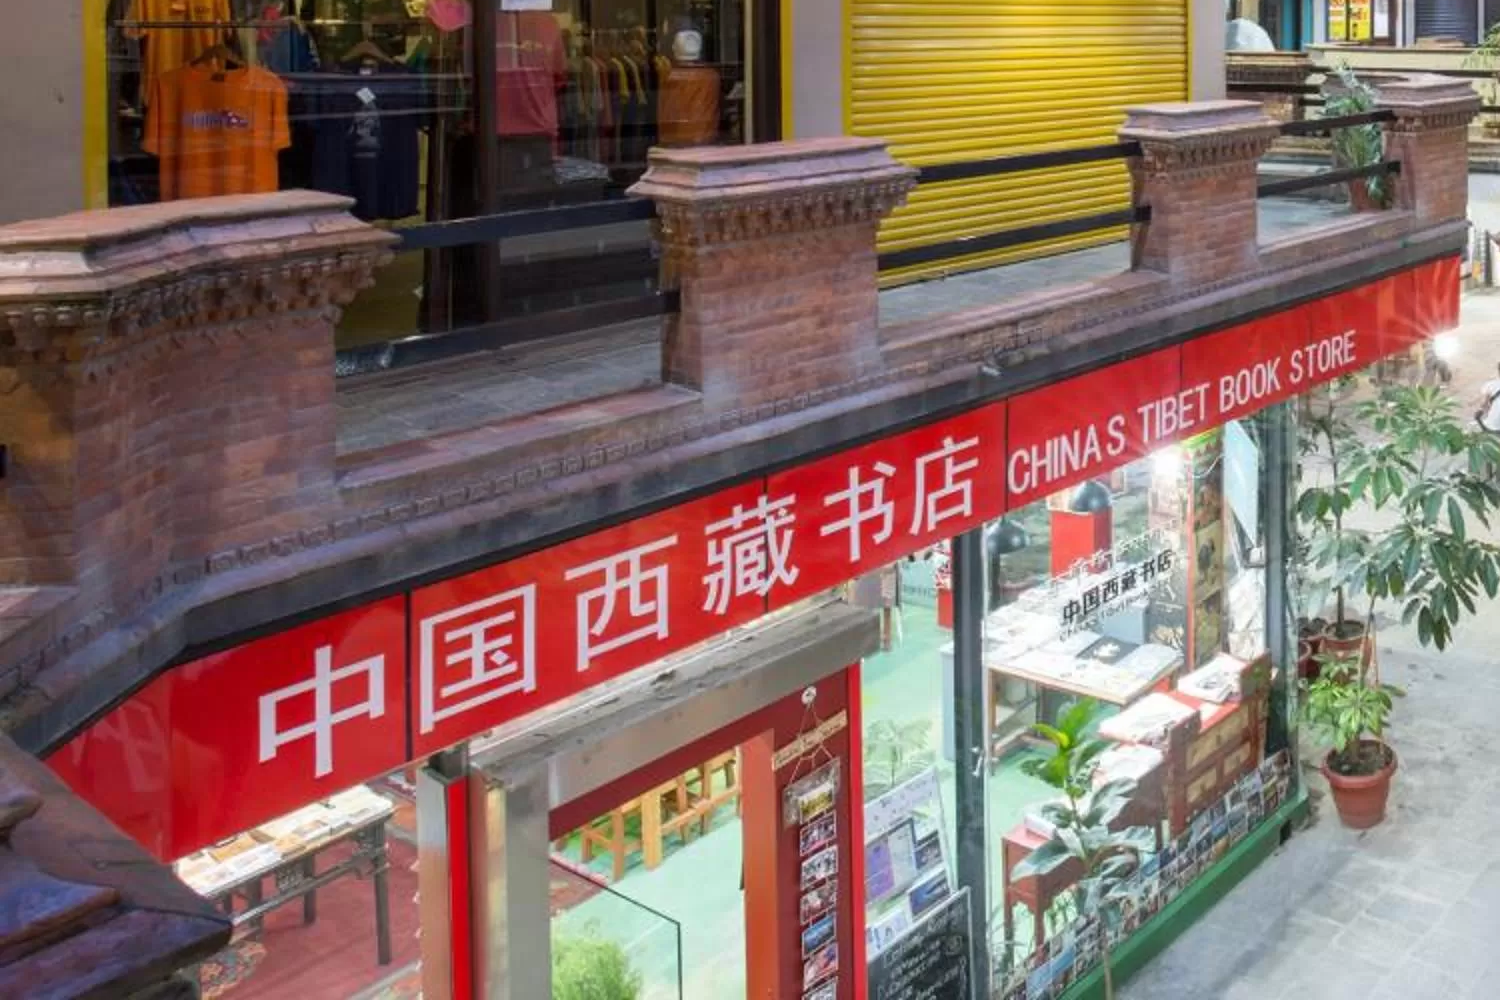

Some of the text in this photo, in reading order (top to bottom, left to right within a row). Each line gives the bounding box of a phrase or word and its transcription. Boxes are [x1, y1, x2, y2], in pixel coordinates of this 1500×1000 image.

[1008, 425, 1101, 495] CHINA
[1138, 382, 1210, 444] TIBET
[1219, 357, 1282, 415] BOOK
[1289, 329, 1357, 384] STORE
[258, 435, 980, 778] 中国西藏书店
